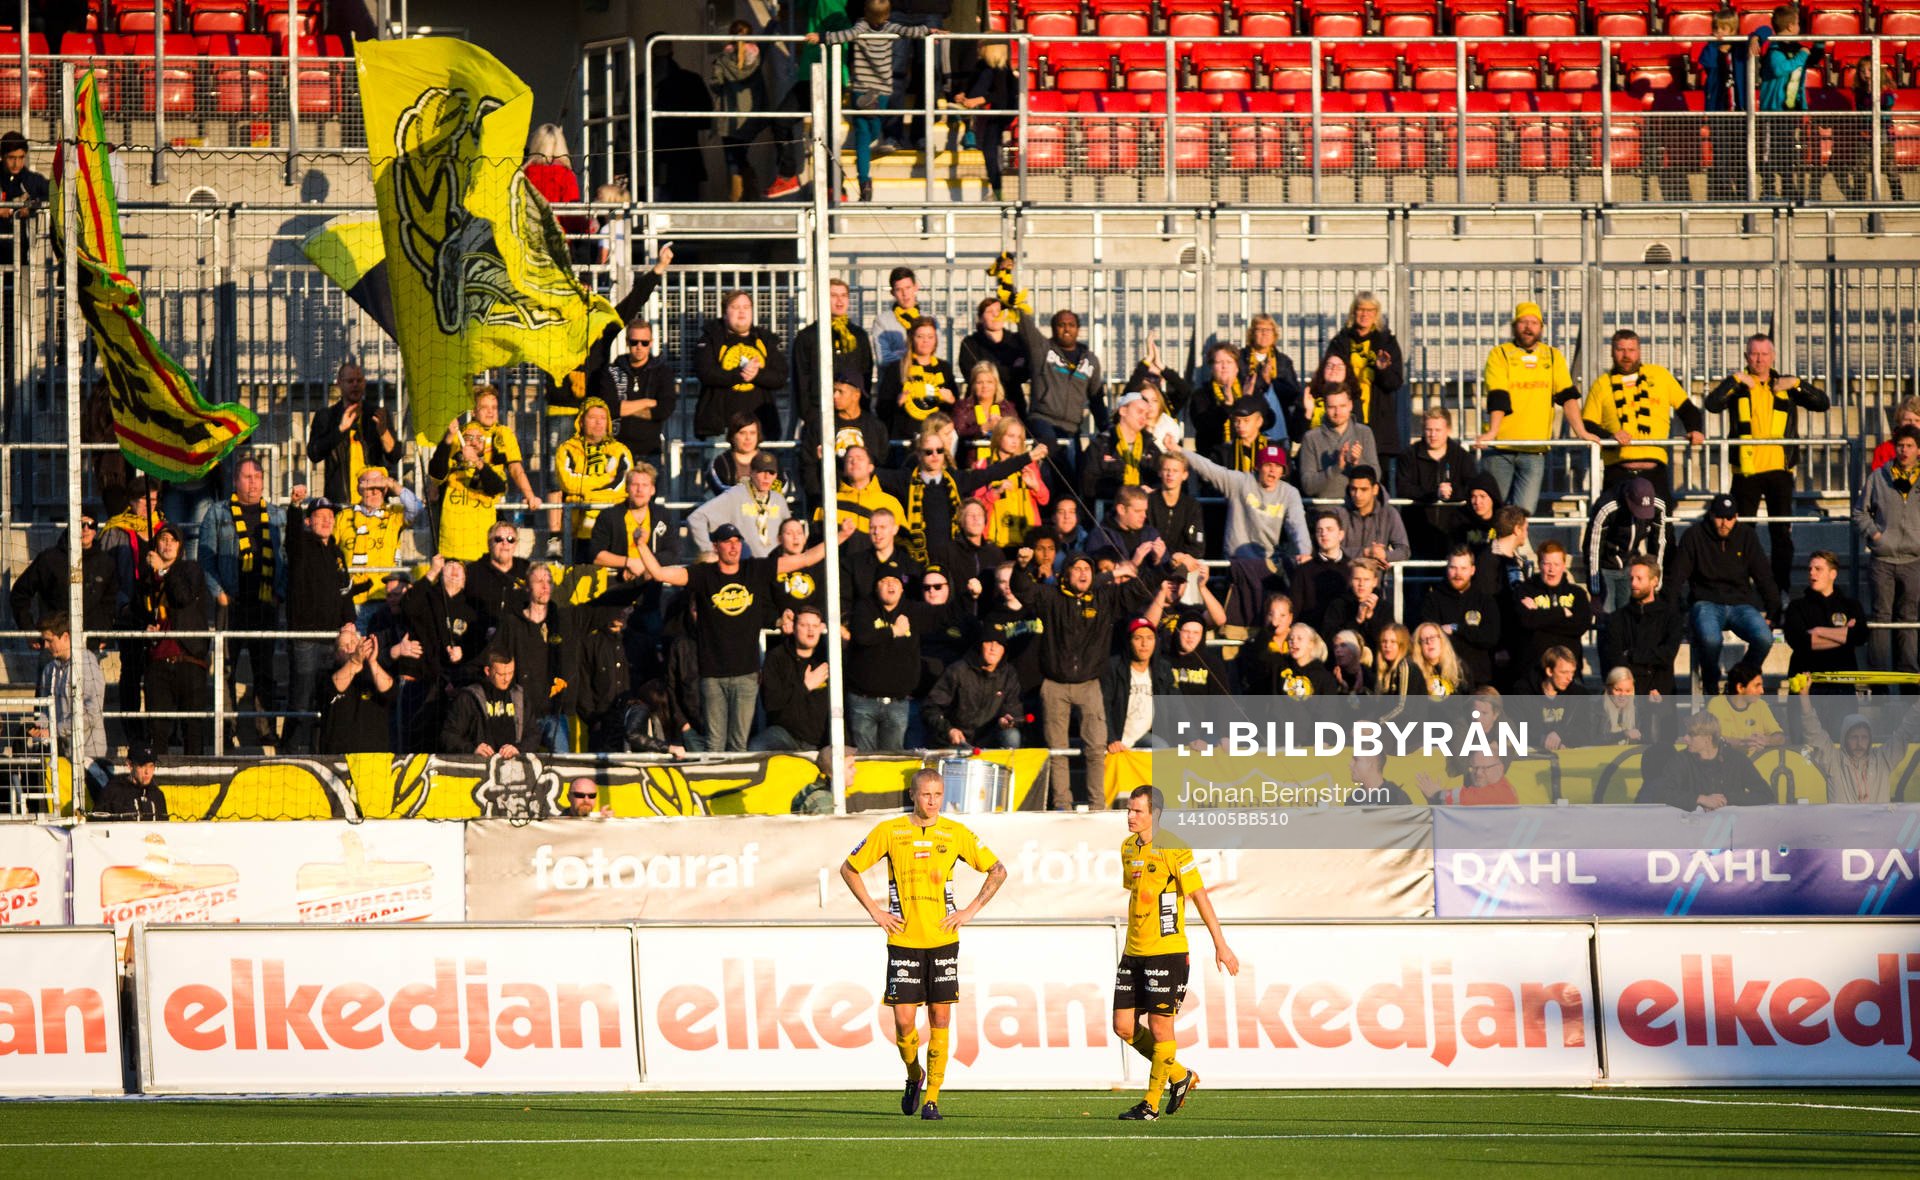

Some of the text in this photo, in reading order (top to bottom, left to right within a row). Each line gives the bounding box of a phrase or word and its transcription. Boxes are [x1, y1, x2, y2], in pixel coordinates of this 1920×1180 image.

[531, 843, 760, 890] fotograf
[1452, 850, 1597, 885] DAHL
[1647, 849, 1791, 883] DAHL
[1841, 848, 1920, 881] DA
[164, 958, 622, 1069] elkedjan
